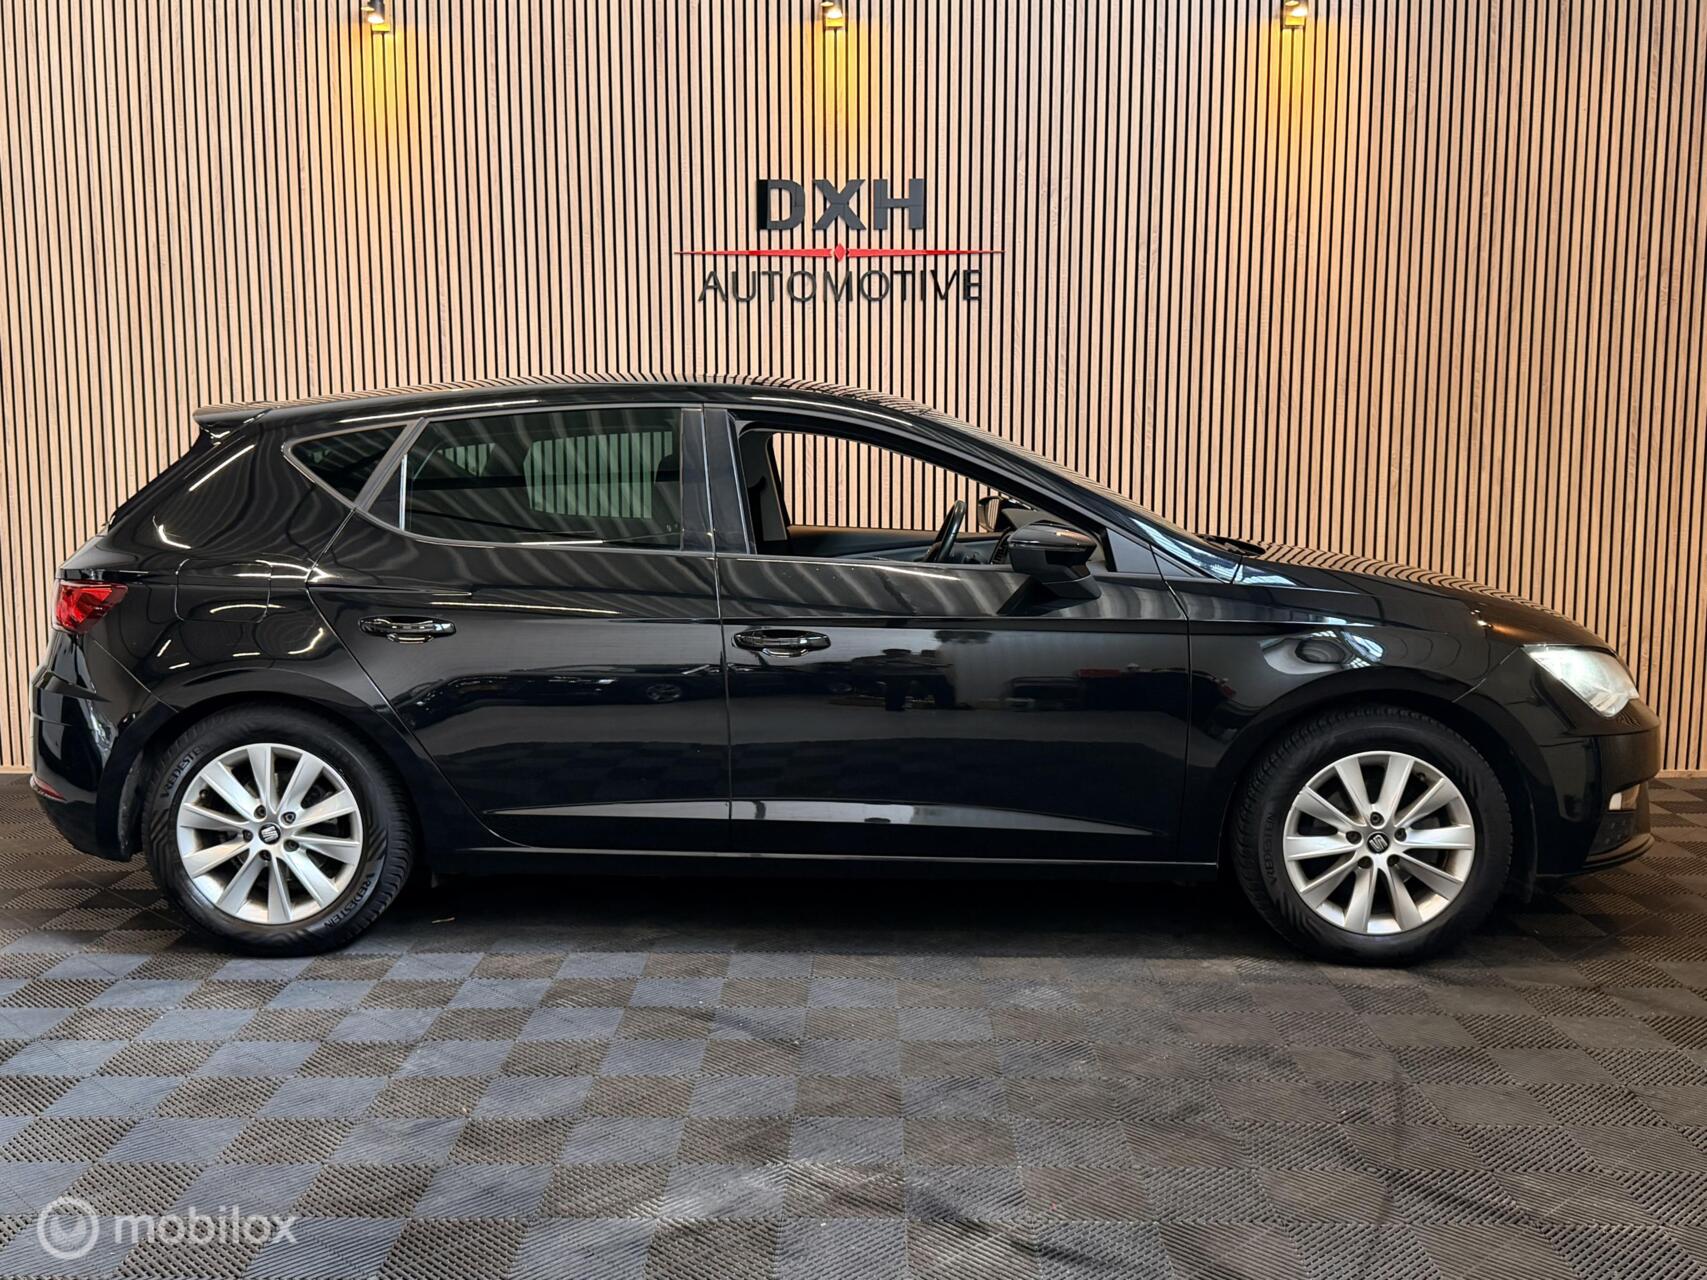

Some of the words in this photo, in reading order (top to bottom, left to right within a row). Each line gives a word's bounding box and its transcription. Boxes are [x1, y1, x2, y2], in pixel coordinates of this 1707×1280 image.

[756, 178, 927, 231] DXH
[698, 269, 982, 302] AUTOMOTIVE
[324, 872, 375, 928] VREDESTEIN
